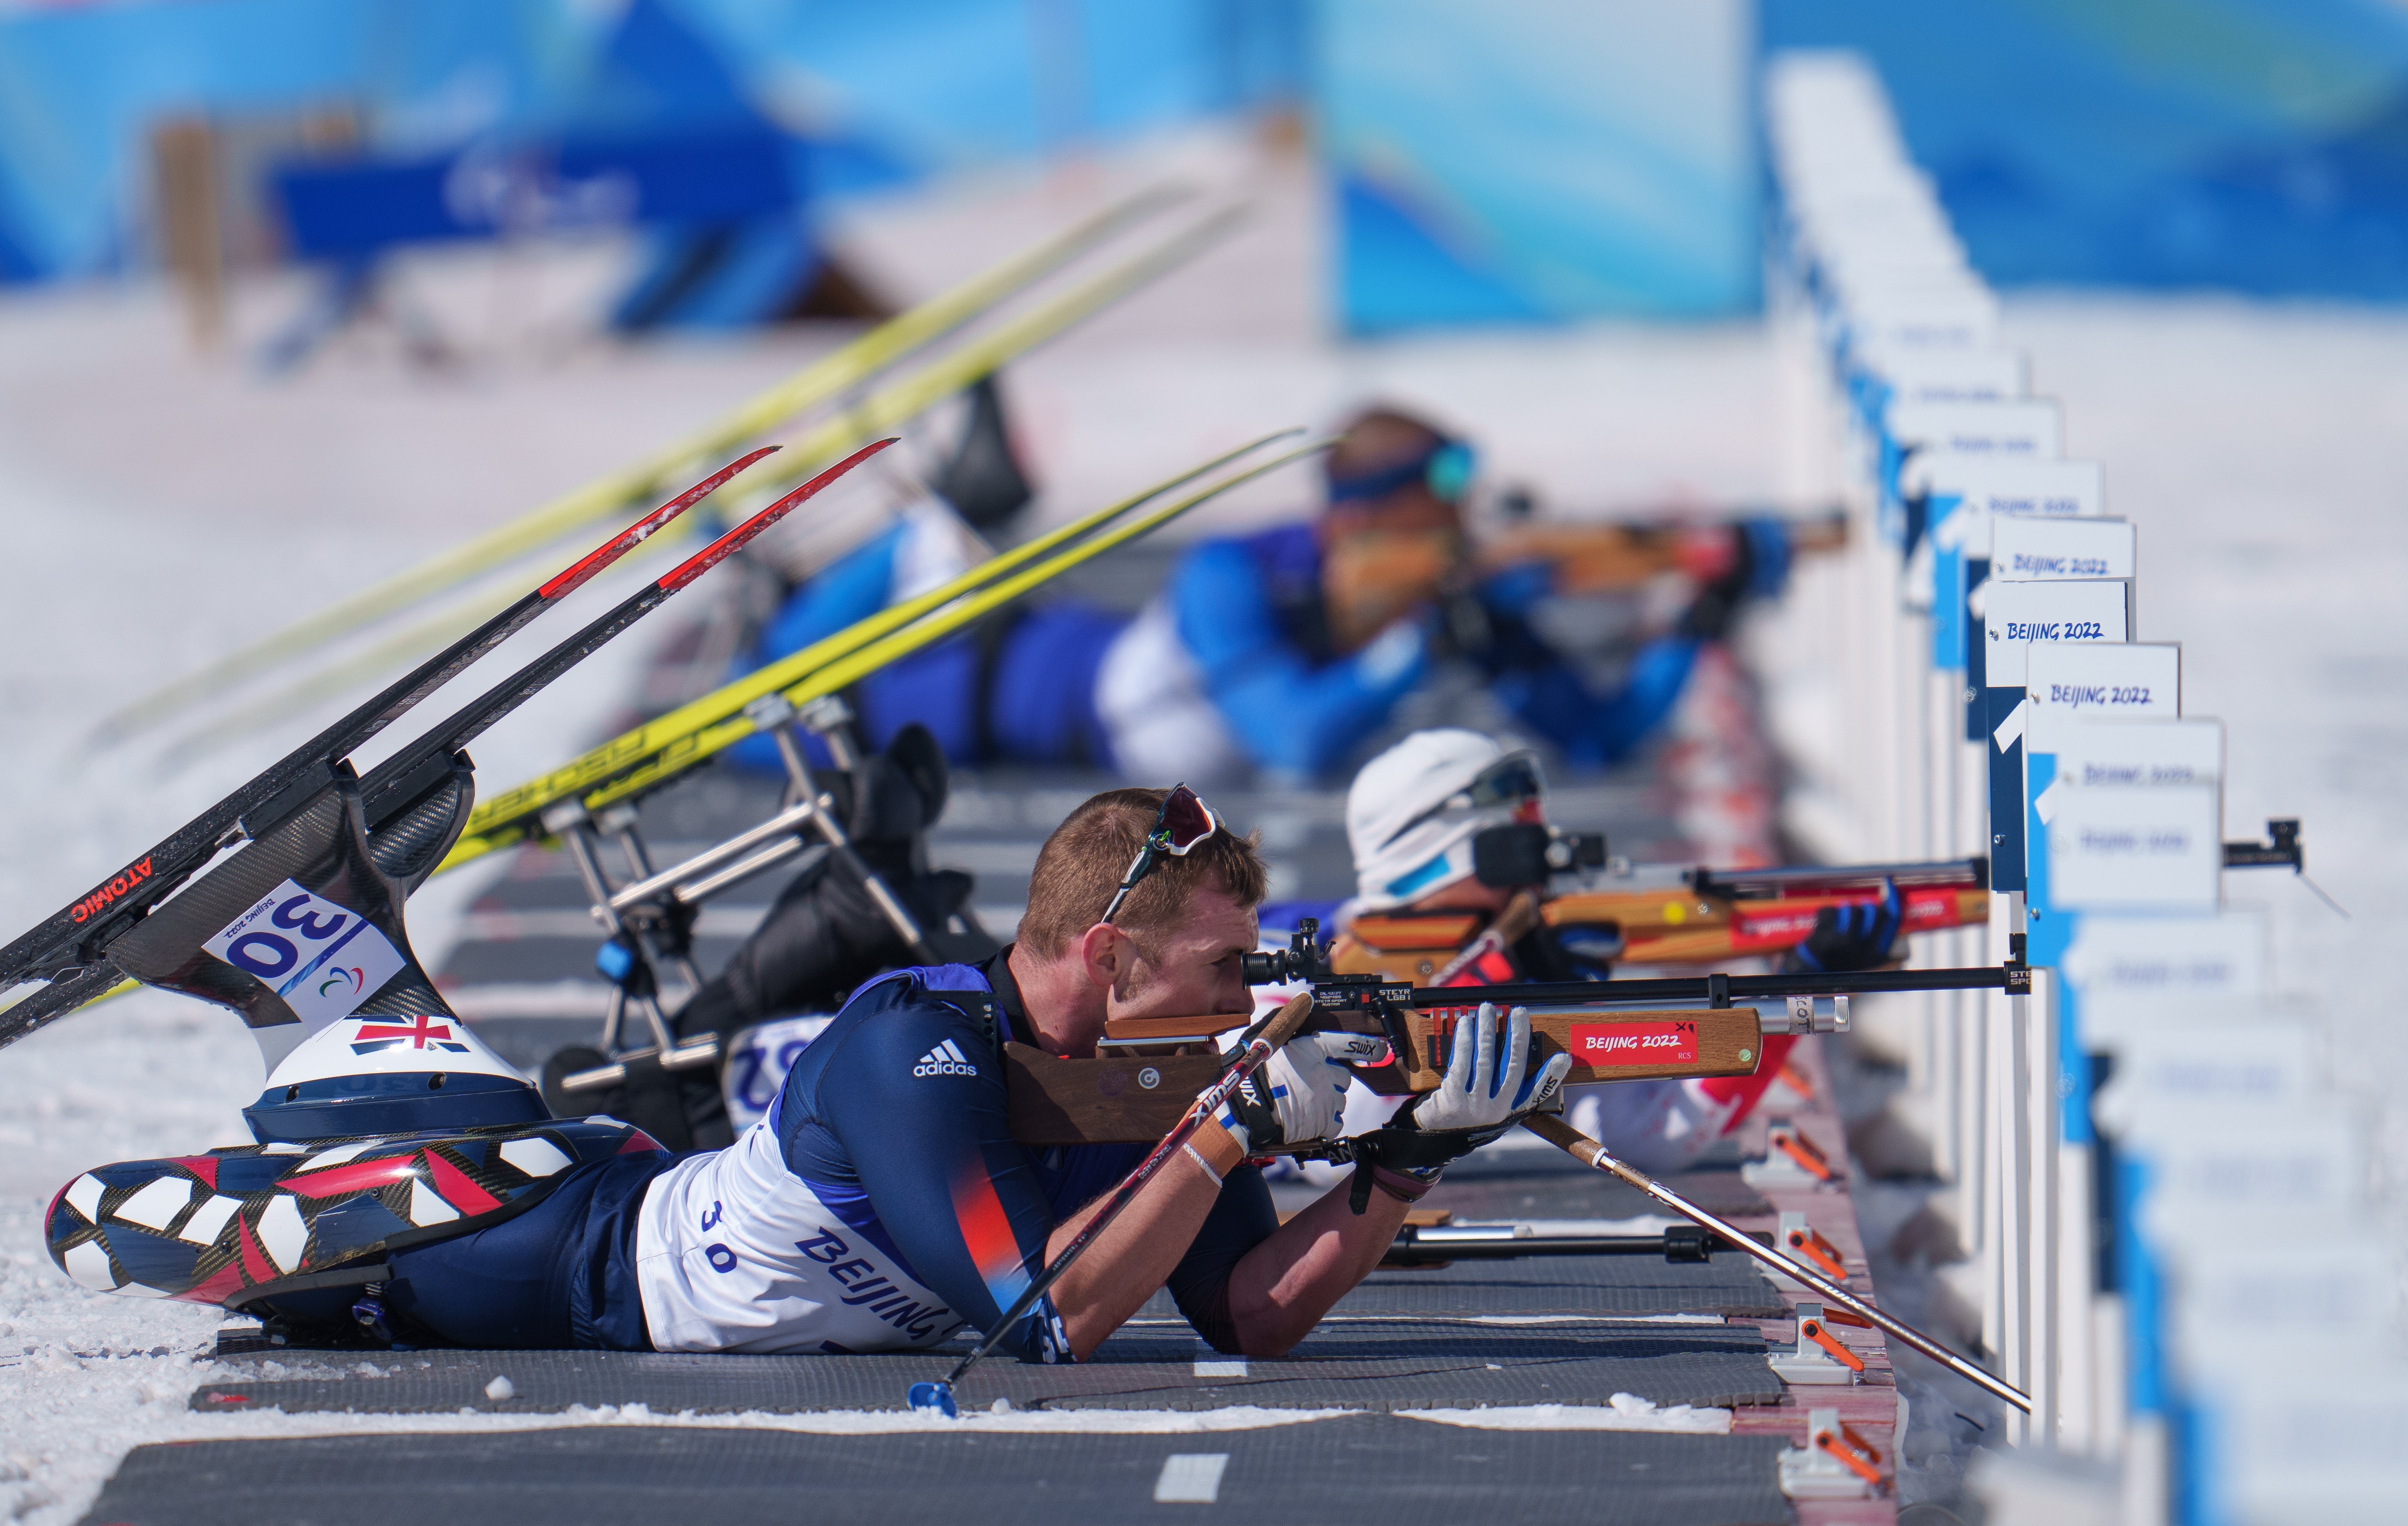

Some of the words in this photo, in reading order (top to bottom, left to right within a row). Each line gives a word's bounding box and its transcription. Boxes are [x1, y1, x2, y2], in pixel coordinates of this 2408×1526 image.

[2013, 553, 2066, 577] BEIJING
[2071, 558, 2110, 576] 2022
[2007, 623, 2059, 644] BEIJING
[2064, 621, 2105, 639] 2022
[2050, 684, 2106, 709] BEIJING
[2111, 686, 2154, 705] 2022
[70, 856, 152, 923] ATOMIC
[246, 898, 276, 923] BEIJING
[223, 919, 247, 938] 2022
[226, 893, 348, 979] 30
[1585, 1036, 1637, 1052] BEIJING
[1641, 1034, 1683, 1048] 2022
[913, 1061, 977, 1077] adidas
[794, 1226, 950, 1341] BEIJING
